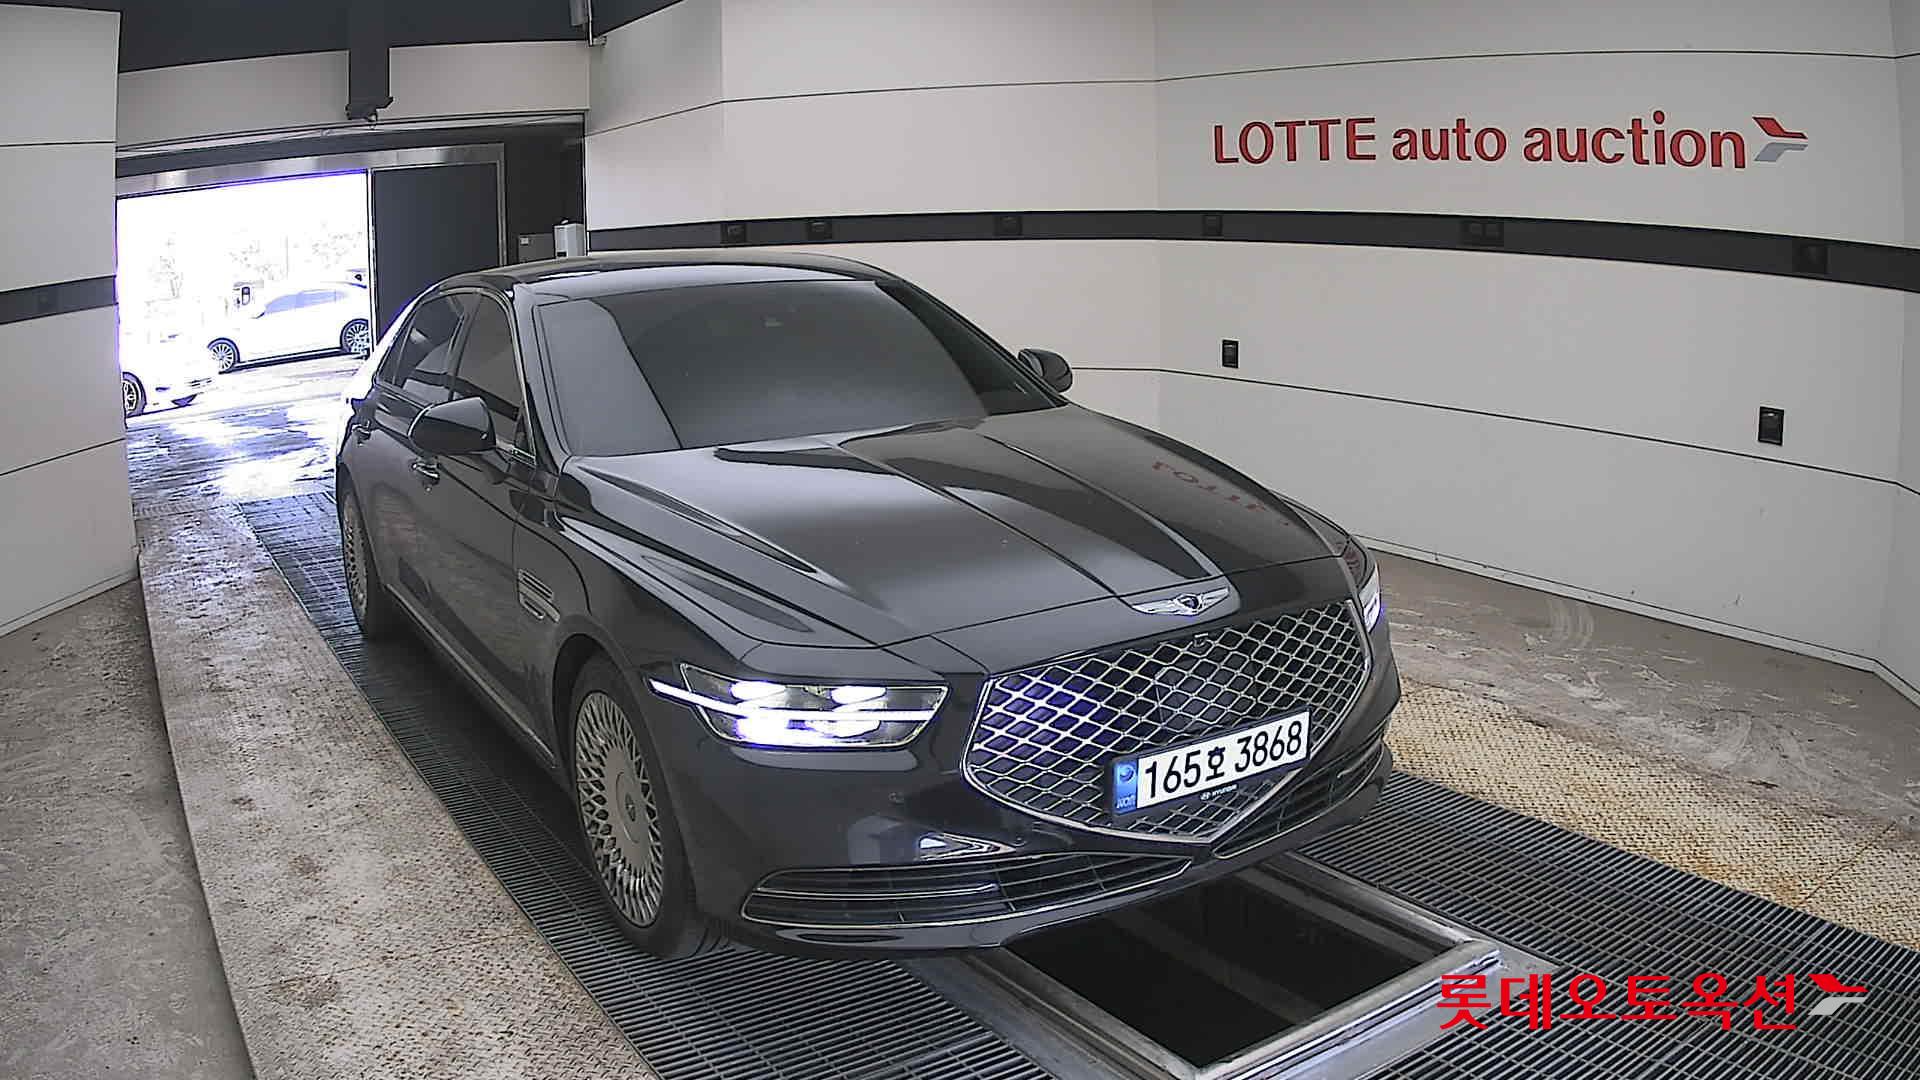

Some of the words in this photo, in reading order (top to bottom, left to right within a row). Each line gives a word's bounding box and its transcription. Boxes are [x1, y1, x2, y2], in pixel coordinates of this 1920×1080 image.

[1214, 117, 1377, 165] LOTTE
[1390, 117, 1508, 162] auto
[1522, 110, 1747, 169] auction
[1145, 747, 1226, 798] 165호
[1235, 720, 1301, 773] 3868
